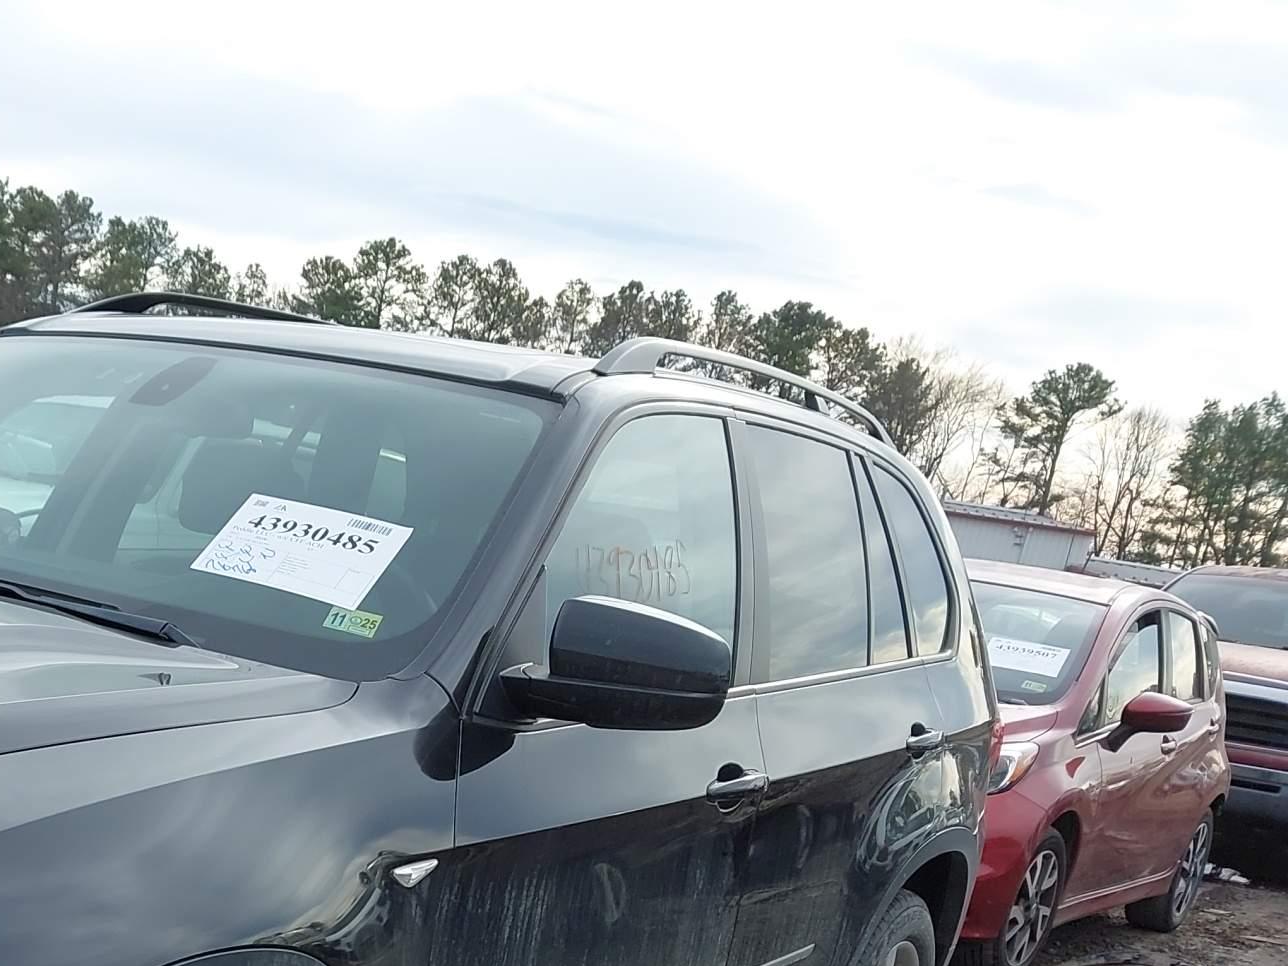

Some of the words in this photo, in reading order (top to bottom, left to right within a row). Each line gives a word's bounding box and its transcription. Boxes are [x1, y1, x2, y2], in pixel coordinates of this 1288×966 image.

[248, 514, 381, 555] 43930485
[330, 612, 347, 627] 11
[360, 617, 378, 630] 25
